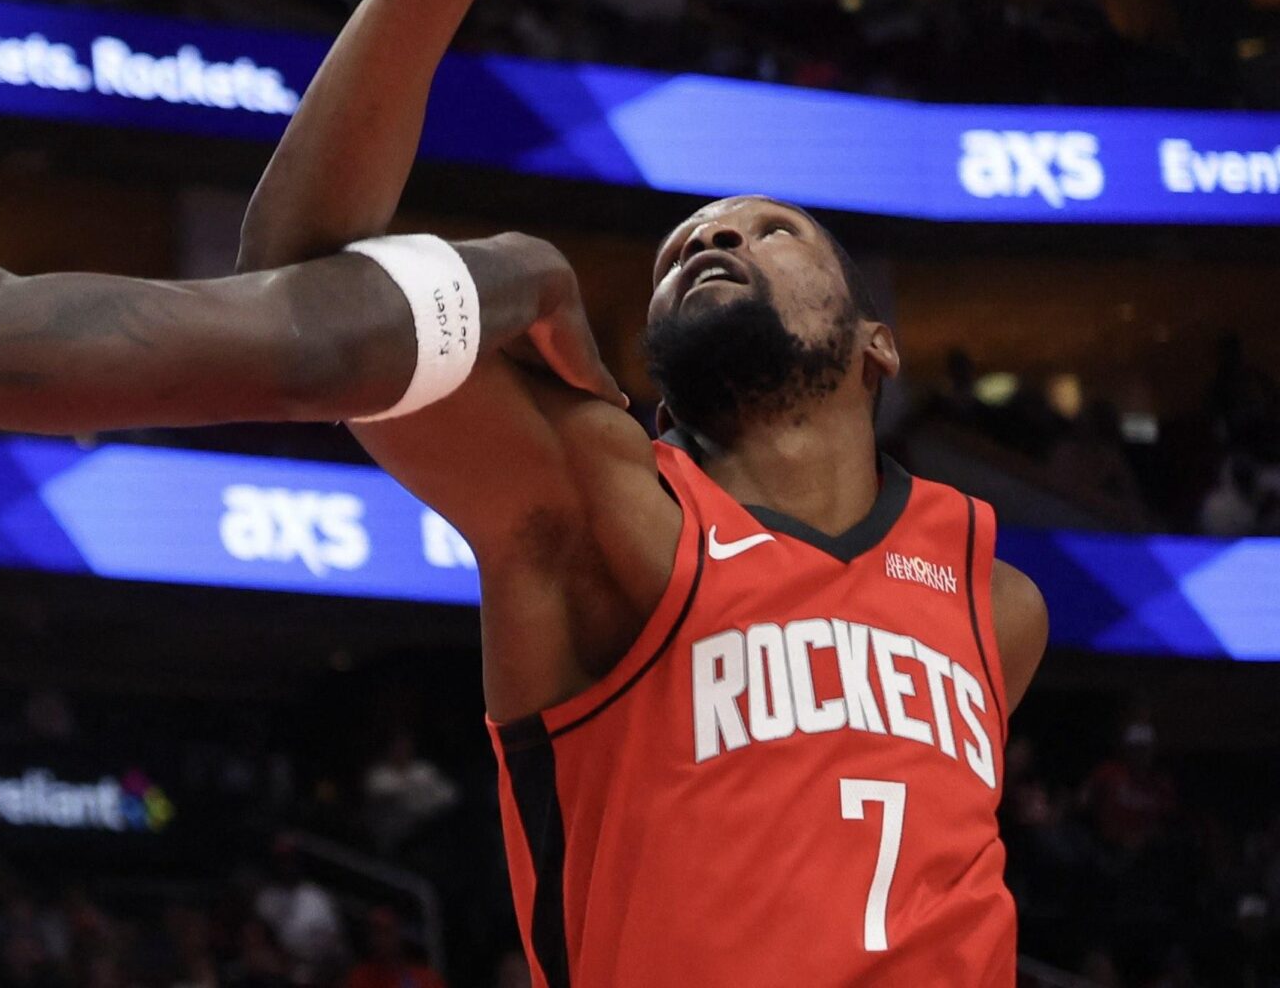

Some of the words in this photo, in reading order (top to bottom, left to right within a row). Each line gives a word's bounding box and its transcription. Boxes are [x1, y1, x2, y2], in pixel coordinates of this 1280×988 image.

[92, 36, 300, 114] Rockets.
[958, 129, 1104, 209] axs
[1159, 138, 1280, 195] Even
[220, 484, 370, 578] axs
[885, 551, 956, 583] MEMORIAL
[885, 562, 957, 594] HERMANN
[692, 618, 997, 790] ROCKETS
[839, 778, 907, 952] 7
